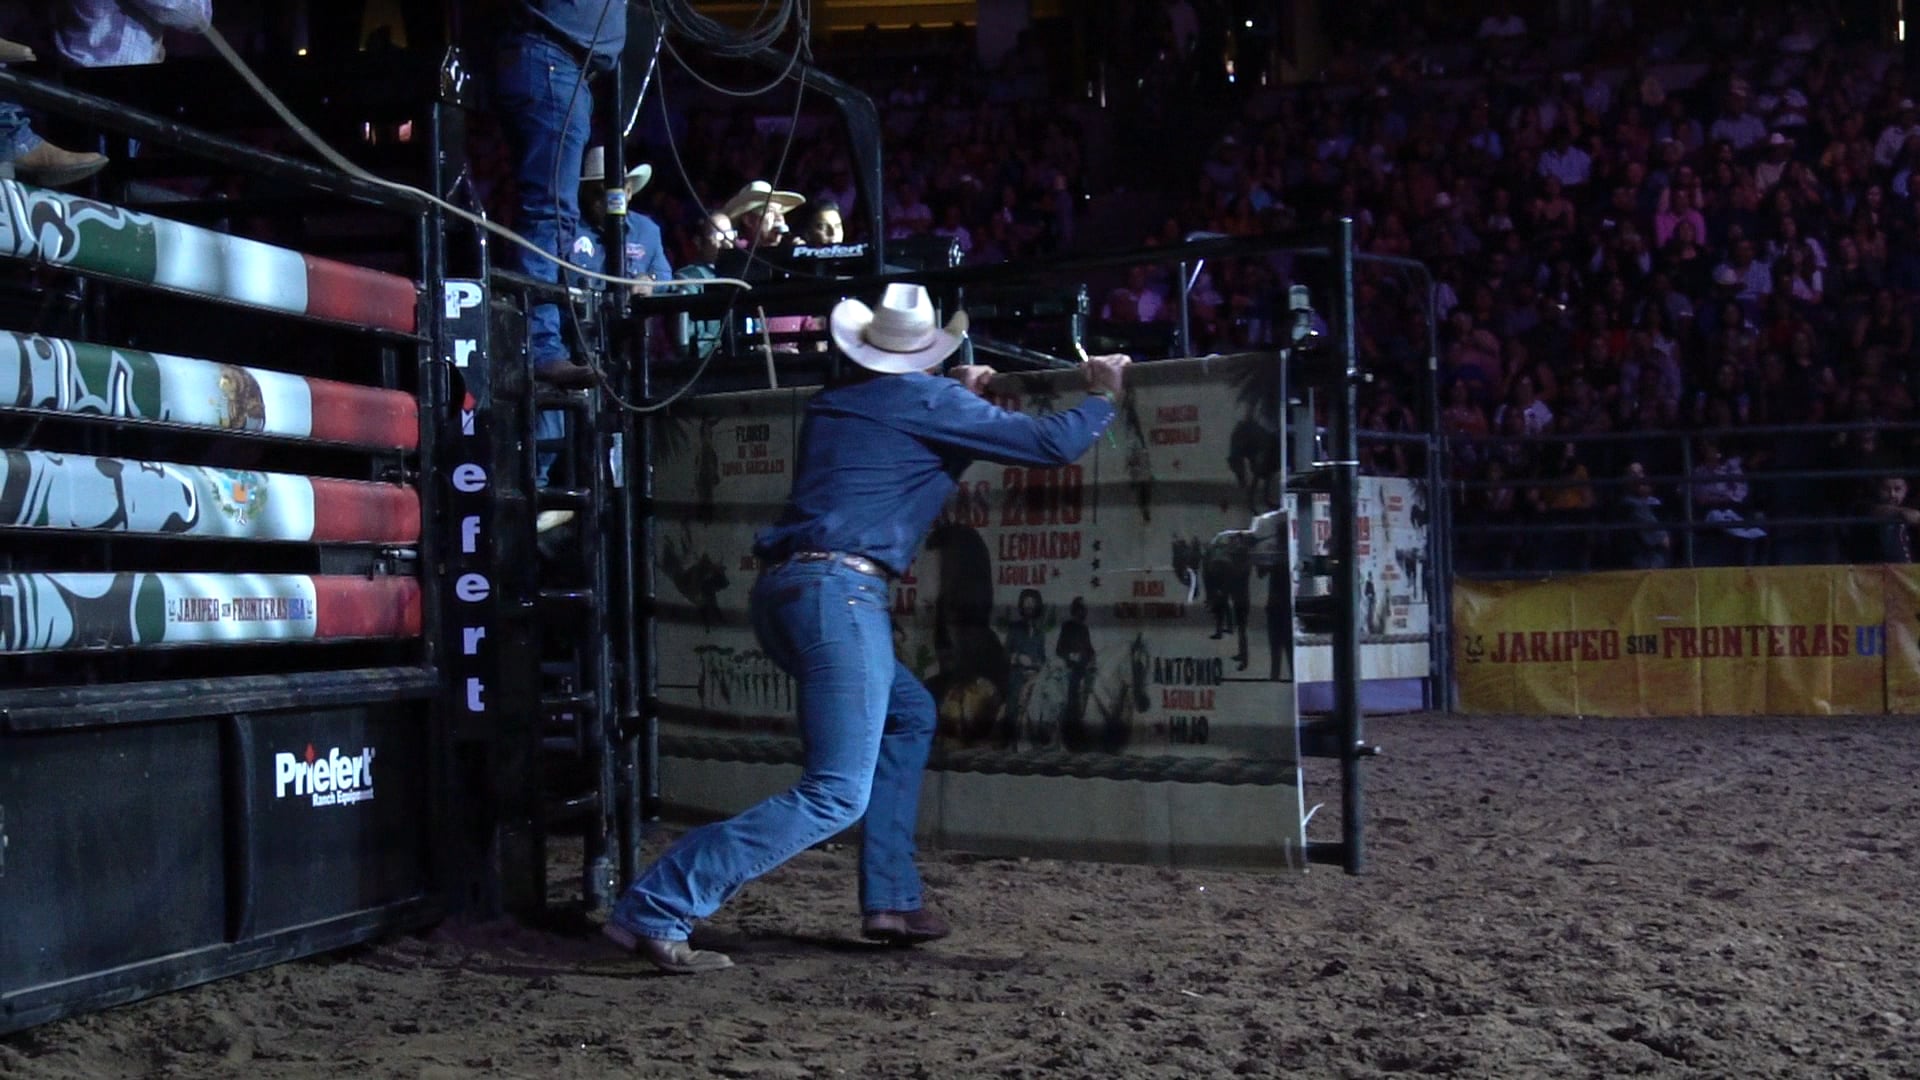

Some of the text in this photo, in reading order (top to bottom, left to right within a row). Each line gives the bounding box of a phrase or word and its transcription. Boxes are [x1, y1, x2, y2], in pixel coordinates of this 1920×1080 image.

[999, 532, 1080, 561] LEONARDO
[1491, 630, 1619, 663] JARIPEO
[1627, 635, 1657, 654] SIN
[1662, 625, 1849, 659] FRONTERAS
[1154, 656, 1222, 686] ANTONIO
[275, 747, 373, 798] Priefert
